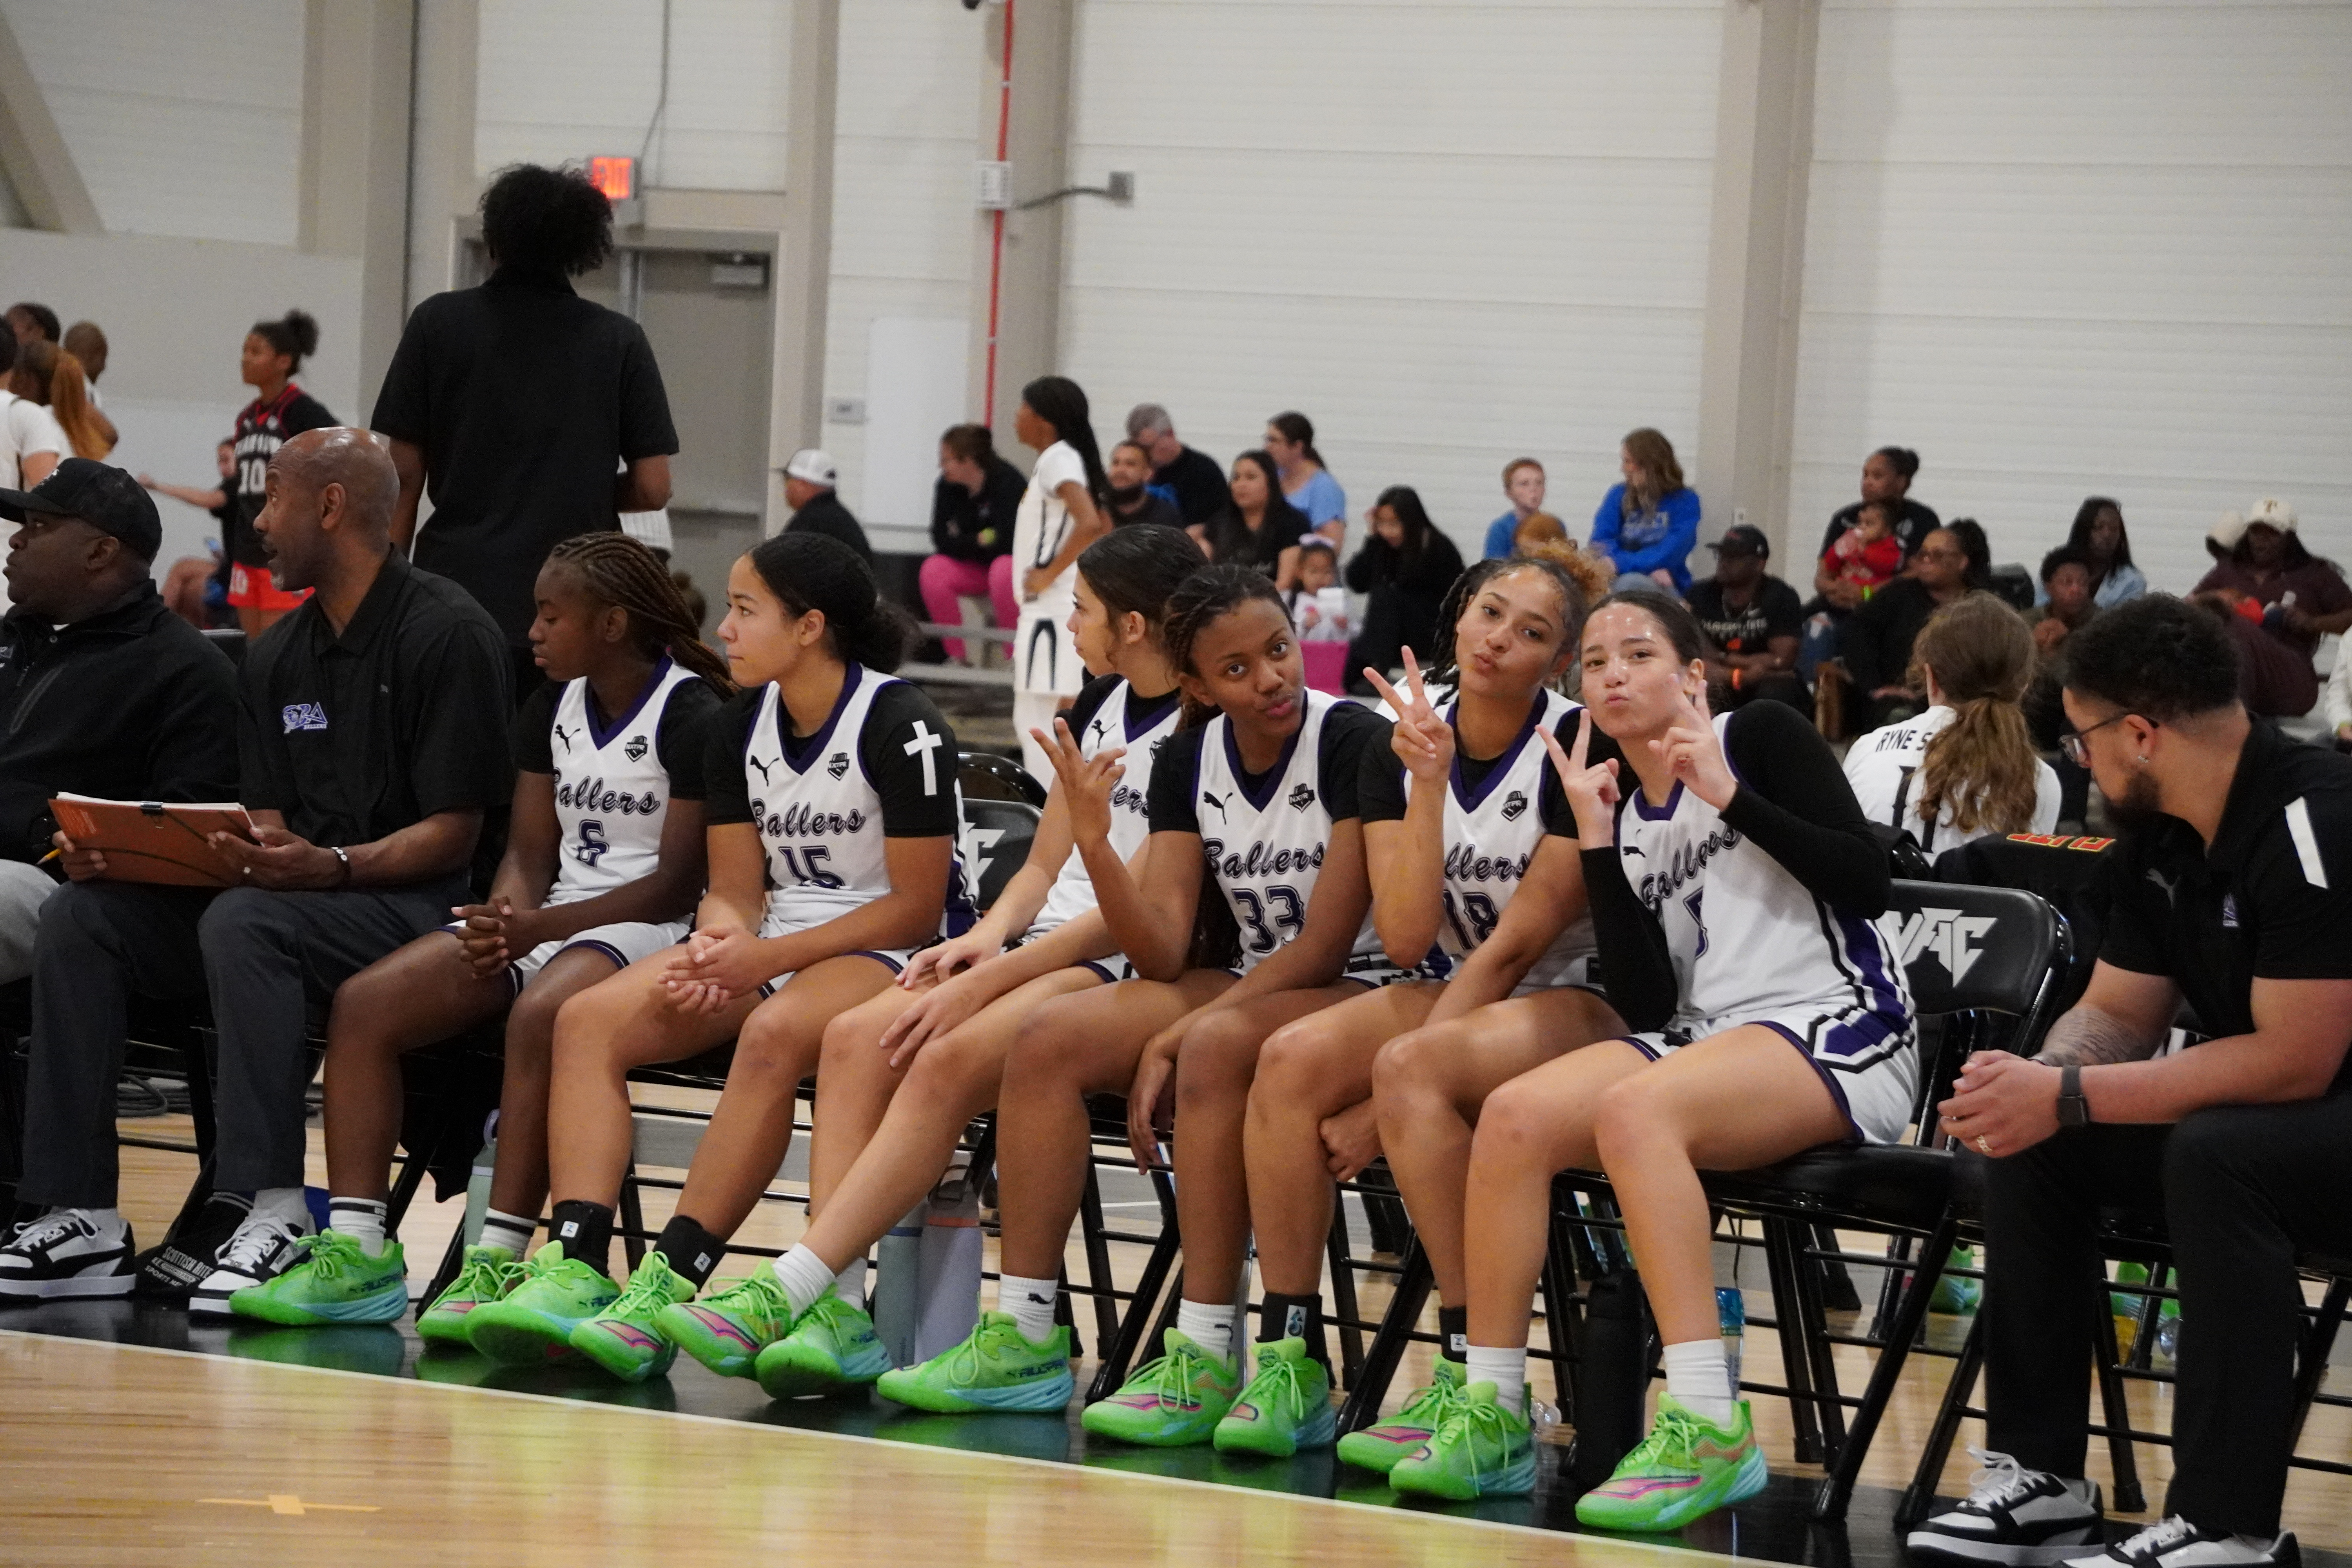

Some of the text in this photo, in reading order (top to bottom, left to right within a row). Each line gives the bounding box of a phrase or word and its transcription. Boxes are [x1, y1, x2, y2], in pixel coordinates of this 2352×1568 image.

[238, 457, 267, 494] 10
[1875, 729, 1918, 752] RYNE
[751, 798, 867, 838] Ballers
[778, 845, 846, 889] 15
[1203, 838, 1325, 879] Ballers
[1444, 842, 1531, 882] llers
[1231, 885, 1306, 954] 33
[1443, 889, 1500, 951] 18
[162, 1246, 198, 1271] SCOTTISH
